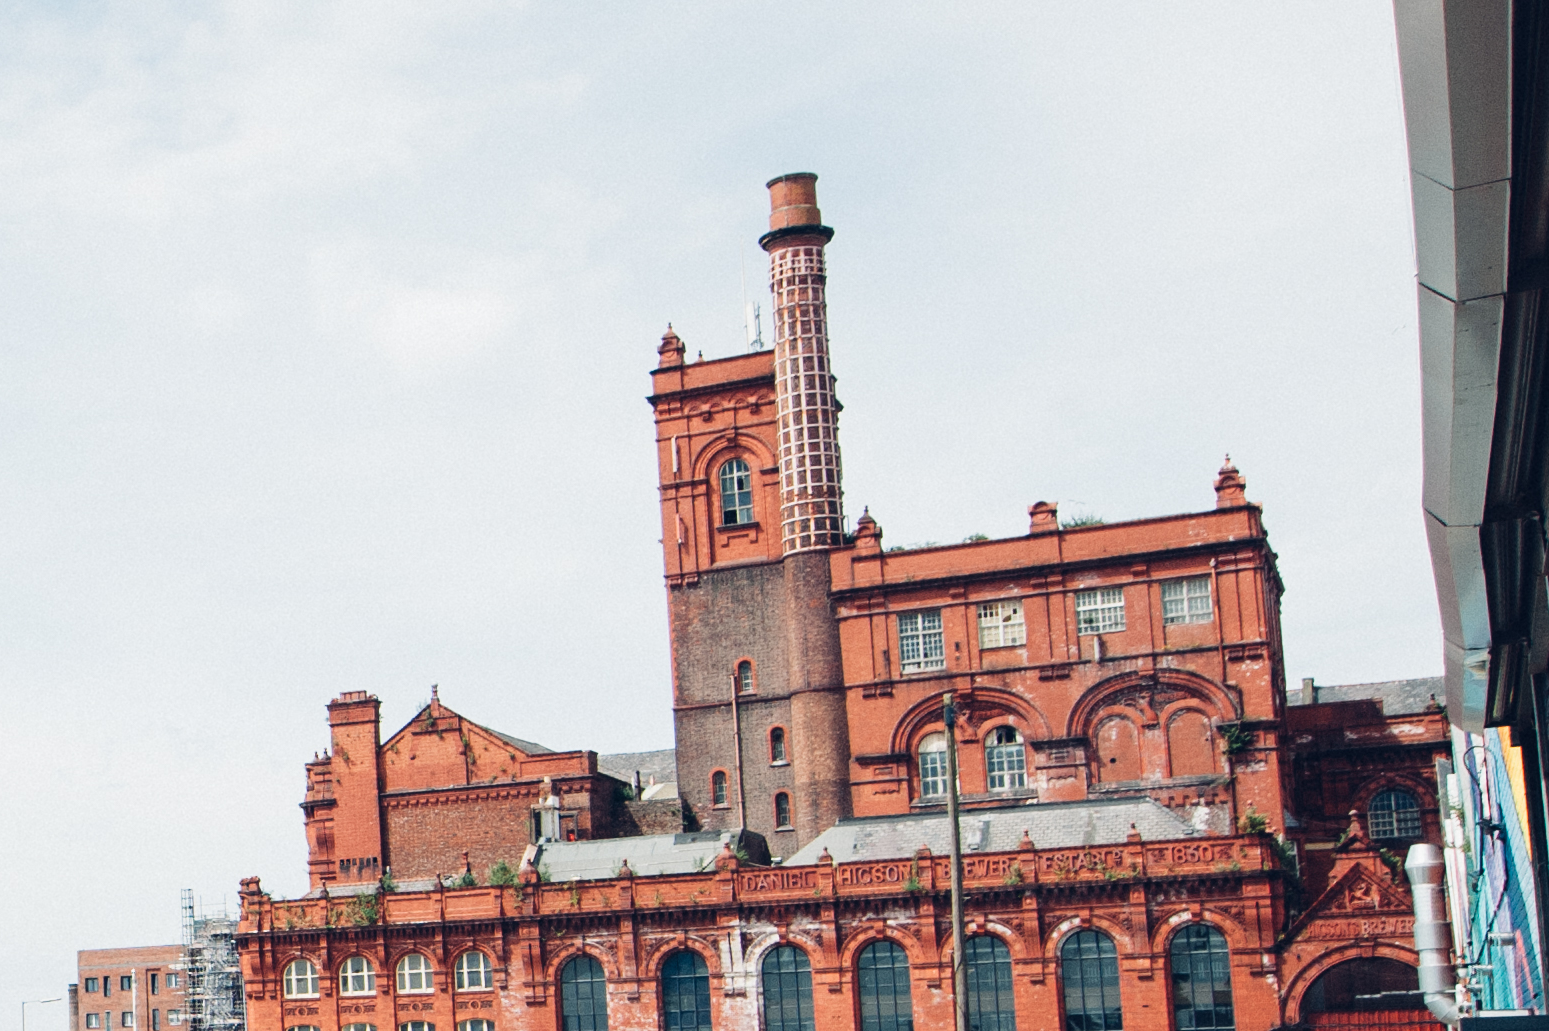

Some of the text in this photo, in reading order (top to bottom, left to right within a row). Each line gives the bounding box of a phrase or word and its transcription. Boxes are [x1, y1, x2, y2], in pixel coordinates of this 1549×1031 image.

[745, 869, 816, 891] DANIEL
[838, 865, 911, 886] HIGSON
[942, 858, 1011, 879] BEWER
